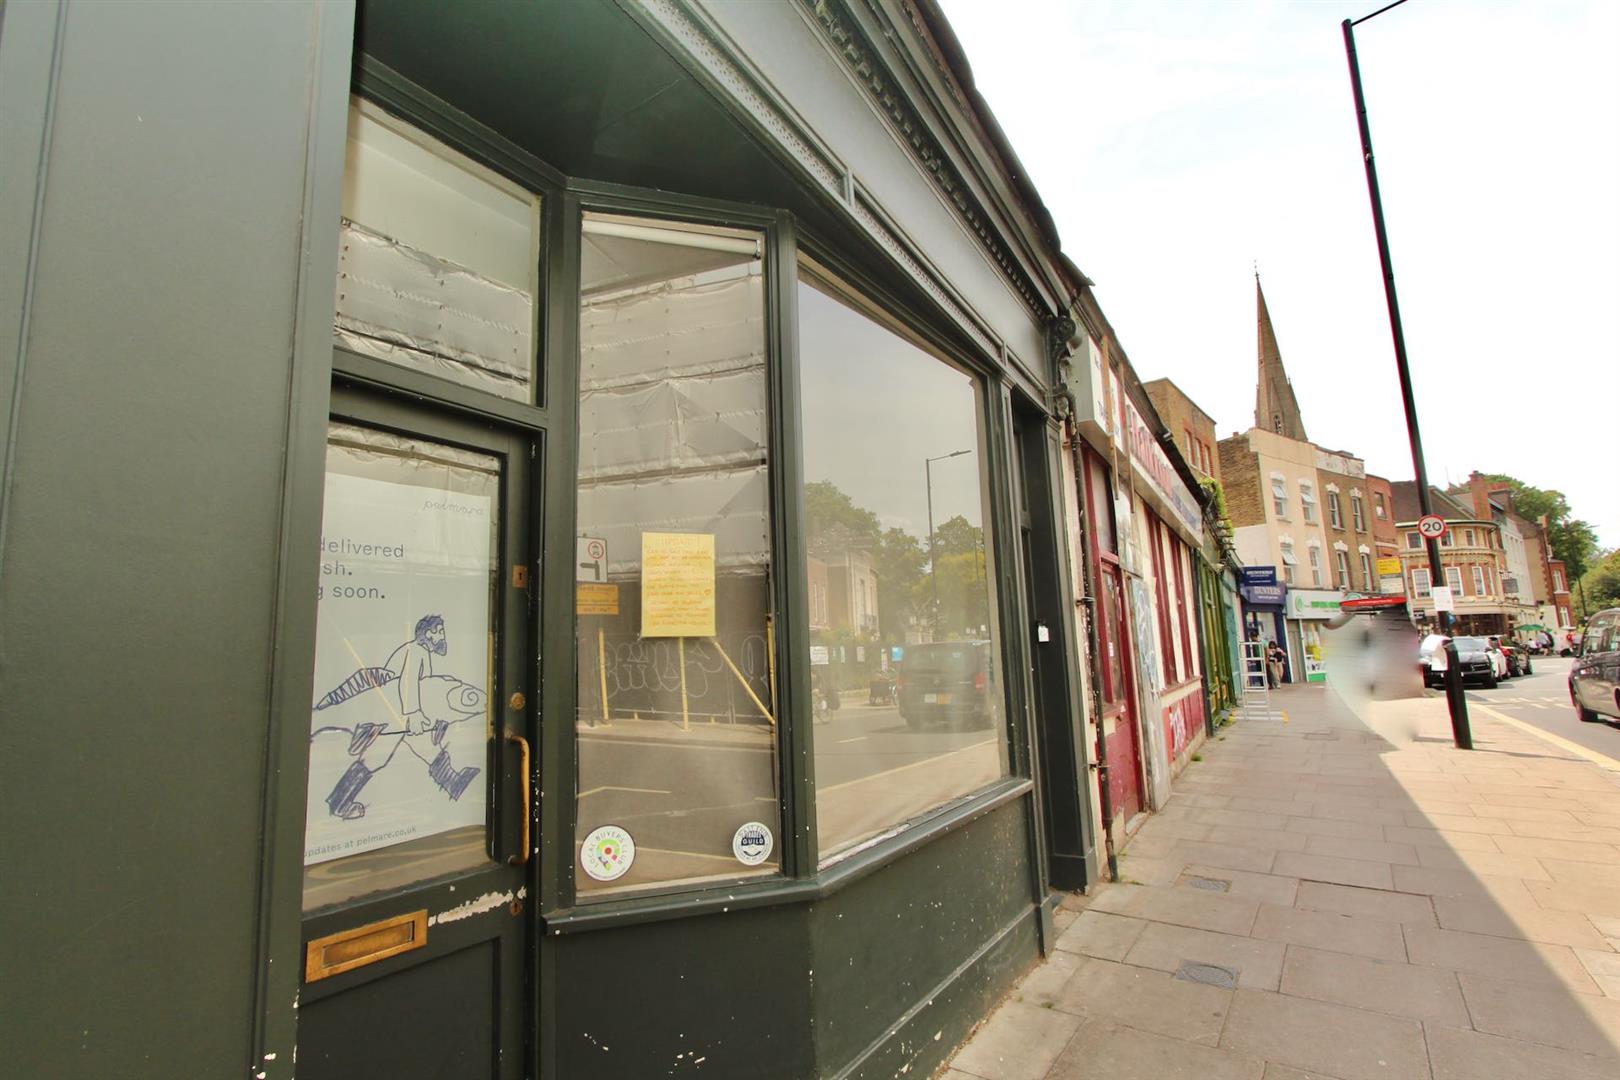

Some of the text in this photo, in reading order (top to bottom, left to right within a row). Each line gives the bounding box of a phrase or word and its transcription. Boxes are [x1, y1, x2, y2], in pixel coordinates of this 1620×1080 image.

[1422, 521, 1442, 532] 20
[333, 586, 385, 599] soon.
[344, 840, 353, 849] at
